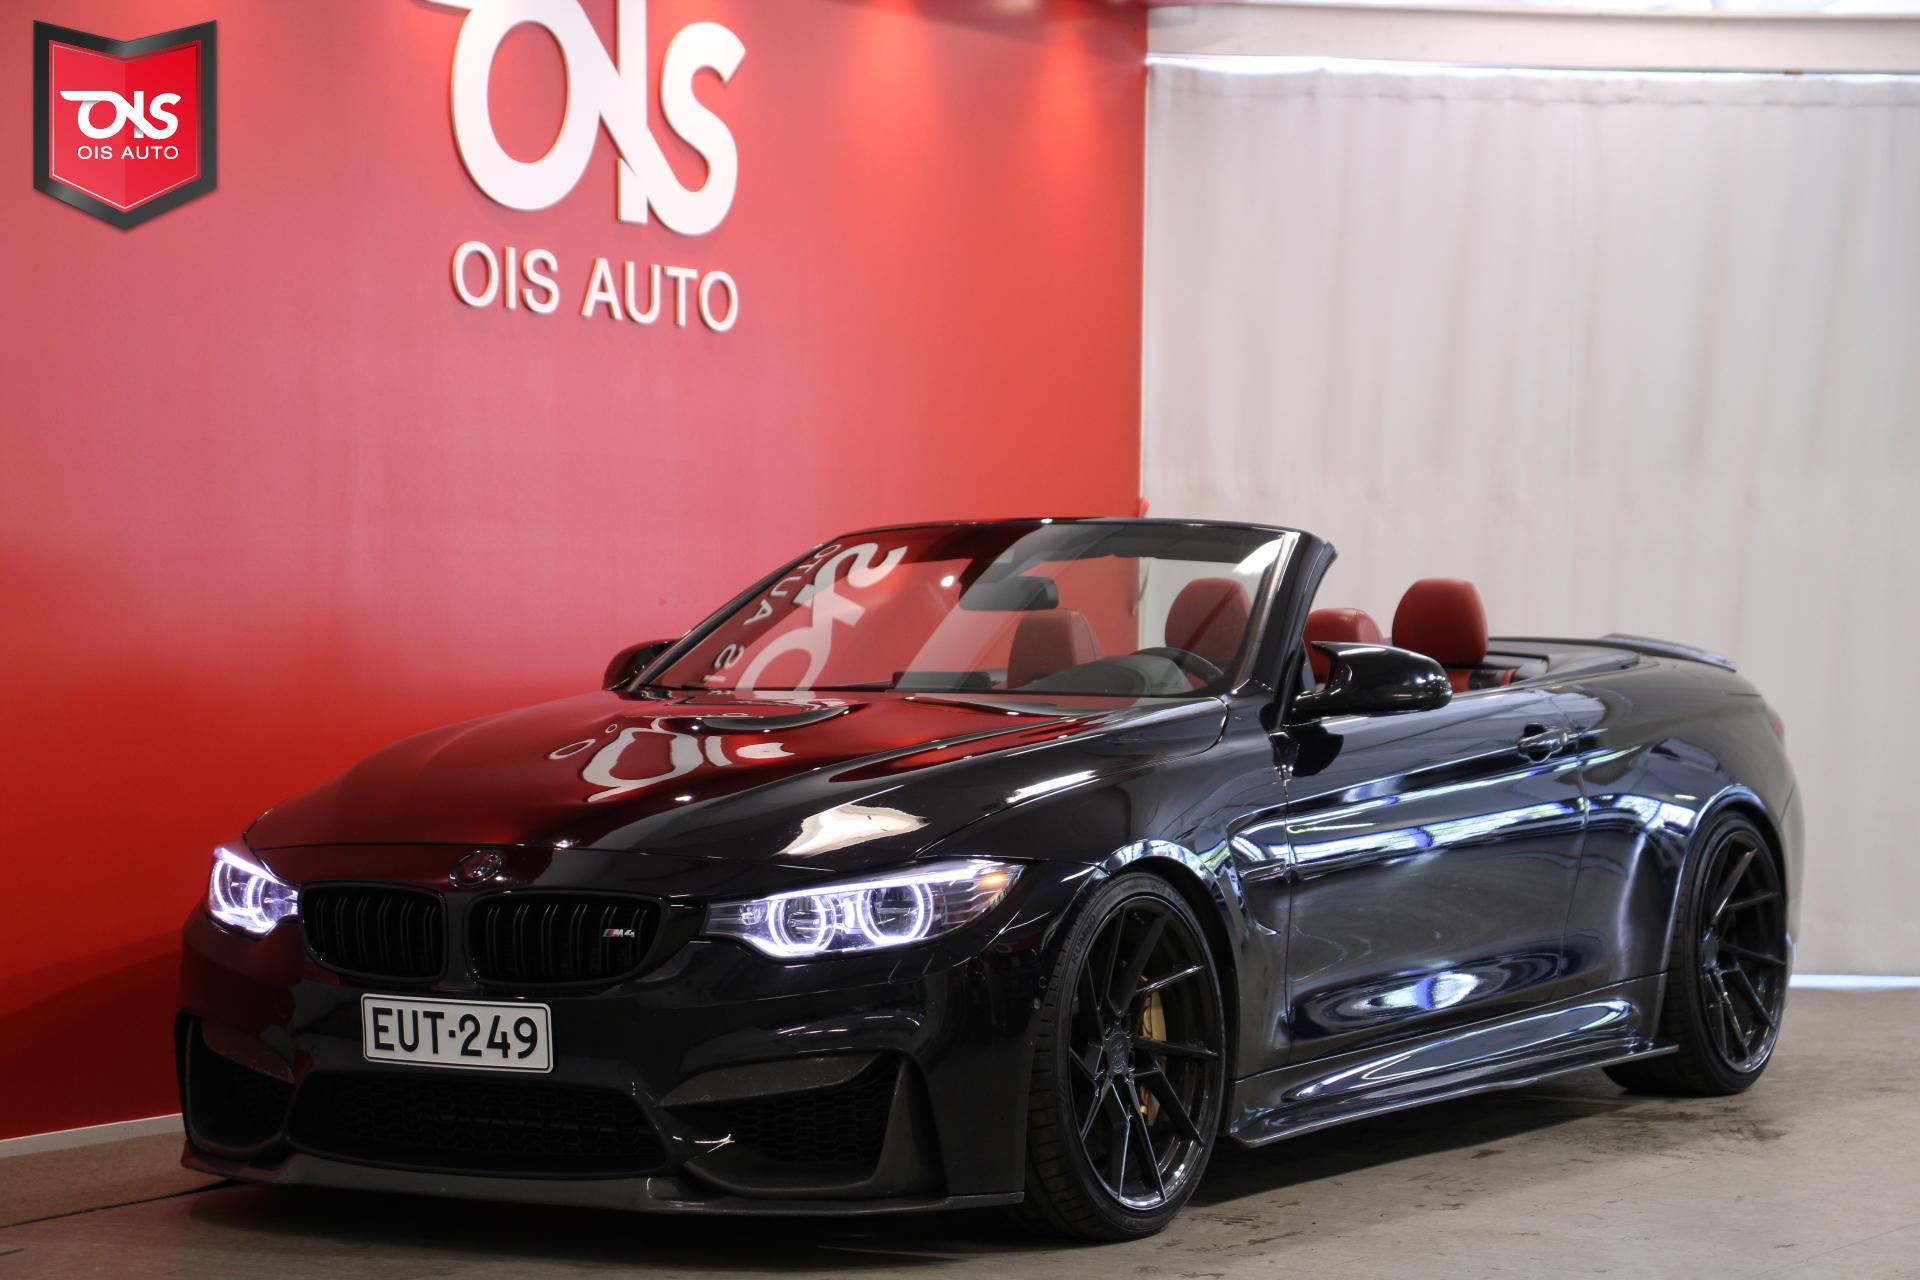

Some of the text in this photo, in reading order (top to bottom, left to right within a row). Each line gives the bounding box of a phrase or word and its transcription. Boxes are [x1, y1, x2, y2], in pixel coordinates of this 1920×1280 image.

[452, 240, 739, 332] OIS AUTO
[372, 1007, 538, 1059] EUT-249
